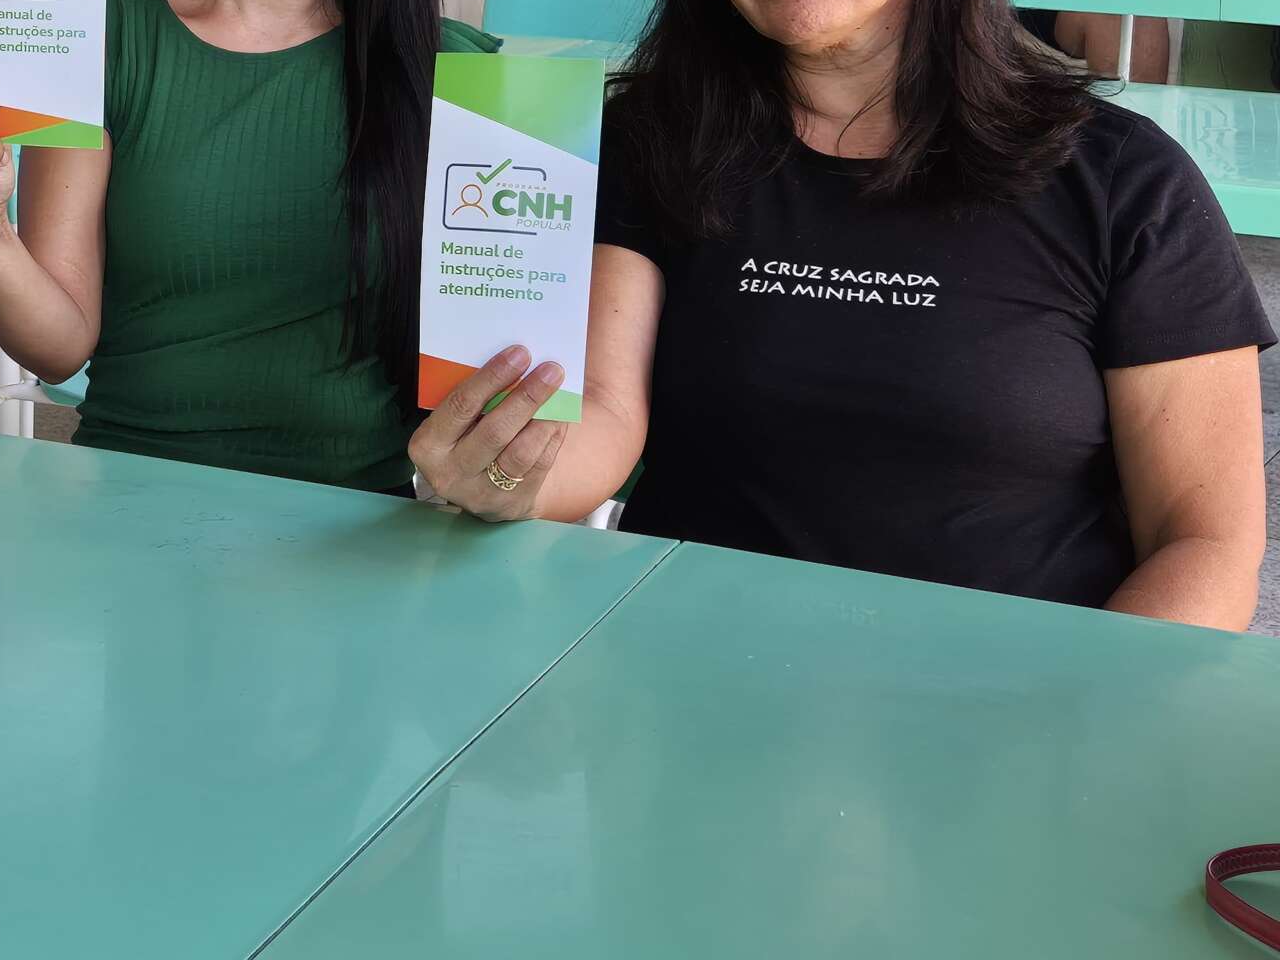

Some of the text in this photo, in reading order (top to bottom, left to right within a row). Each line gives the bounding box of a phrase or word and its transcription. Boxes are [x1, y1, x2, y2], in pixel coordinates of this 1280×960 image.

[37, 10, 52, 20] de
[57, 29, 87, 40] para
[492, 189, 573, 221] CNH
[516, 218, 572, 231] POPULAR
[441, 241, 524, 259] Manual de
[440, 261, 567, 284] instruções para
[741, 258, 940, 287] A CRUZ SAGRADA
[439, 283, 544, 301] atendimento
[738, 279, 937, 307] SEJA MINHA LUZ
